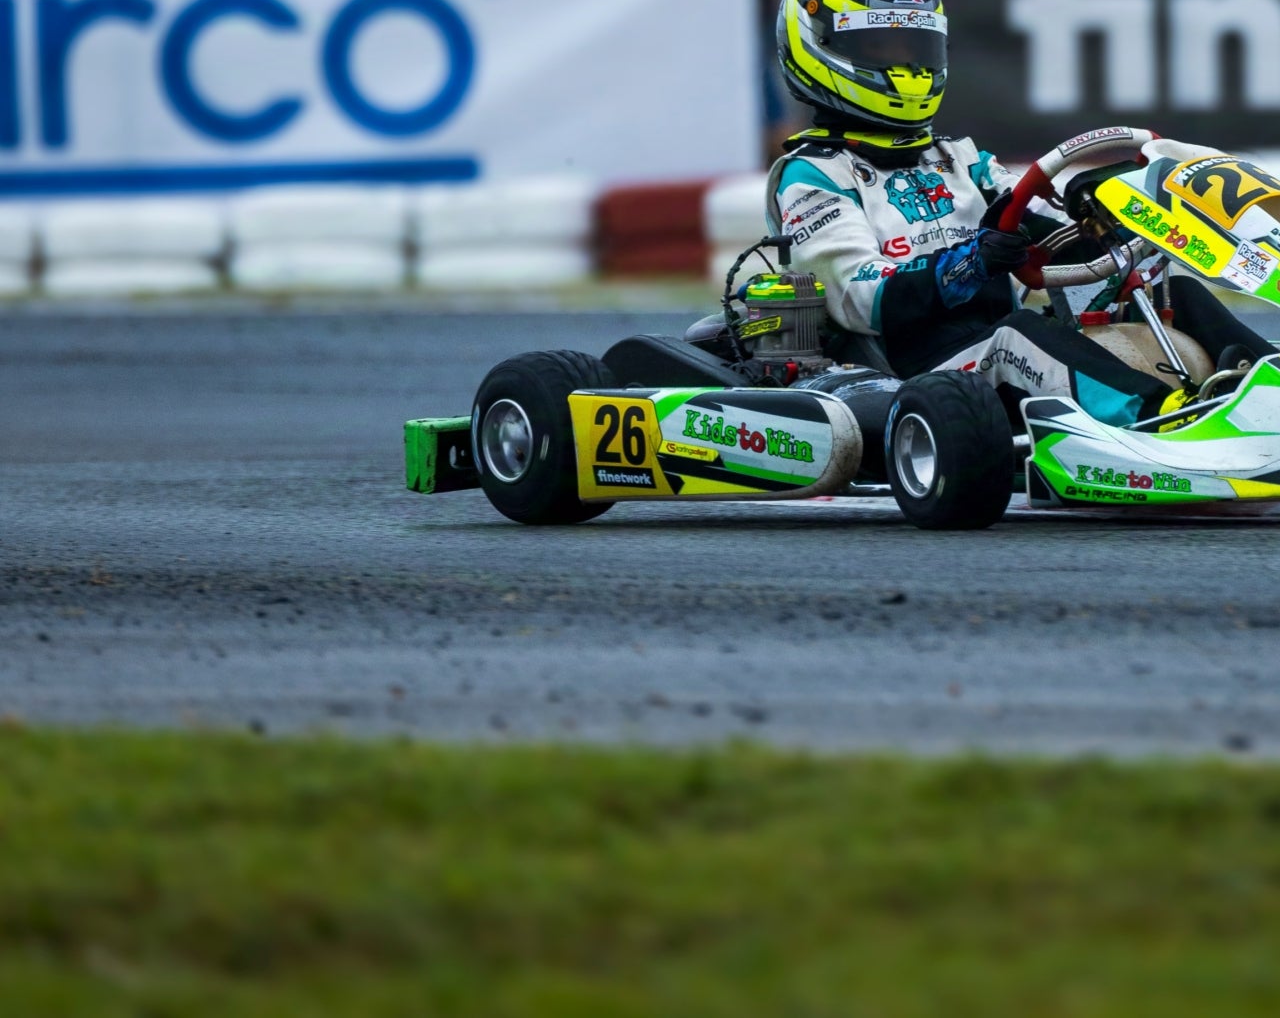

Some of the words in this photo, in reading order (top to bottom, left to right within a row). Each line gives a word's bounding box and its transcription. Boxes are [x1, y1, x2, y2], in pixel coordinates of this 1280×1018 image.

[867, 12, 909, 26] Racing
[909, 12, 937, 28] Spain
[594, 404, 647, 467] 26
[597, 469, 653, 486] finetwork
